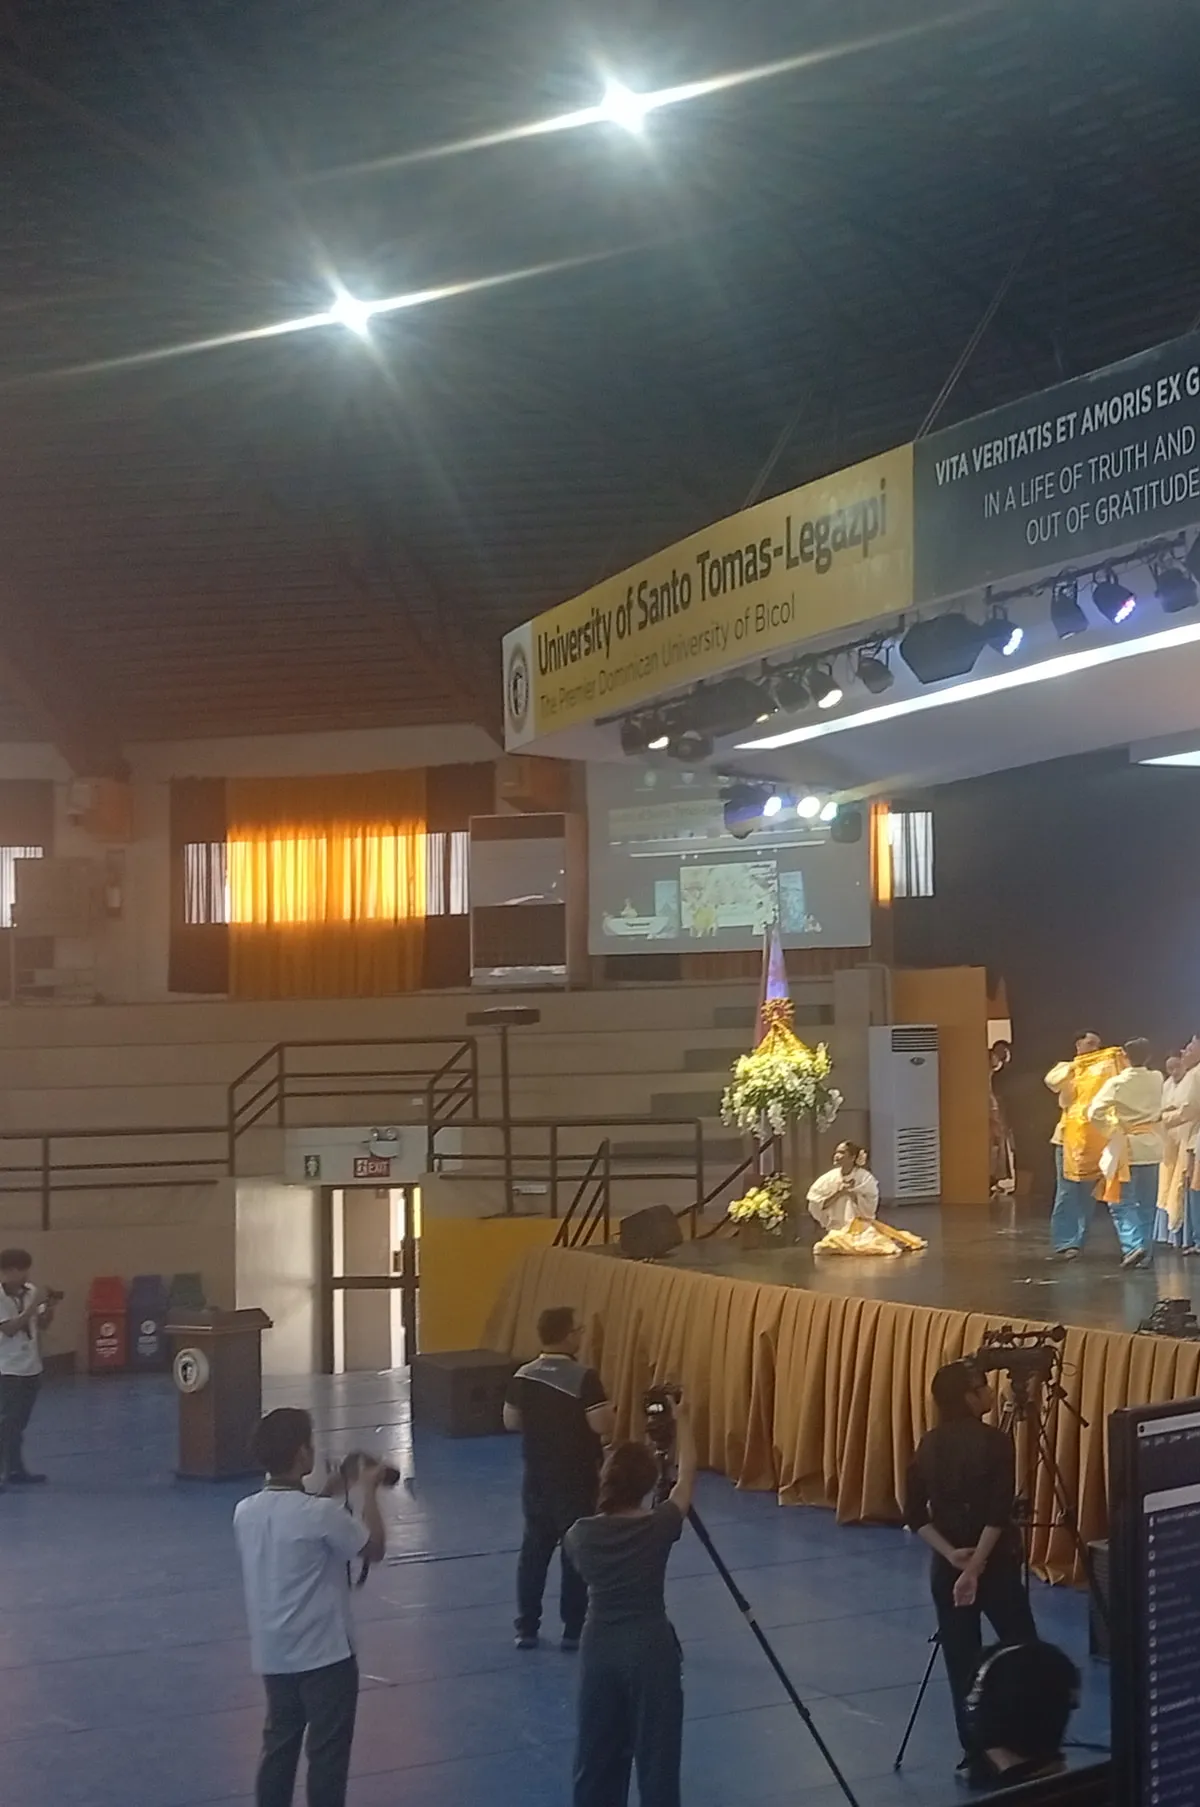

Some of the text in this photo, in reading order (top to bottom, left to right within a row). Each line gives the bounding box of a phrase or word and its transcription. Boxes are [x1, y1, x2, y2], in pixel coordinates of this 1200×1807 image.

[935, 452, 969, 486] VITA
[972, 420, 1052, 473] VERITATIS
[1056, 412, 1077, 444] ET
[1081, 384, 1152, 436] AMORIS
[1156, 372, 1181, 408] EX
[984, 490, 1000, 519] IN
[1004, 486, 1016, 512] A
[1021, 472, 1055, 507] LIFE
[1059, 462, 1083, 494] OF
[1087, 440, 1148, 485] TRUTH
[1153, 426, 1196, 465] AND
[1026, 467, 1200, 545] OUT OF GRATITUDE
[537, 477, 887, 676] University of Santo Tomas-Legazpi
[599, 650, 659, 696] Dominican
[661, 614, 730, 670] University
[734, 606, 752, 641] of
[755, 592, 795, 633] Bicol
[368, 1161, 389, 1174] EXIT
